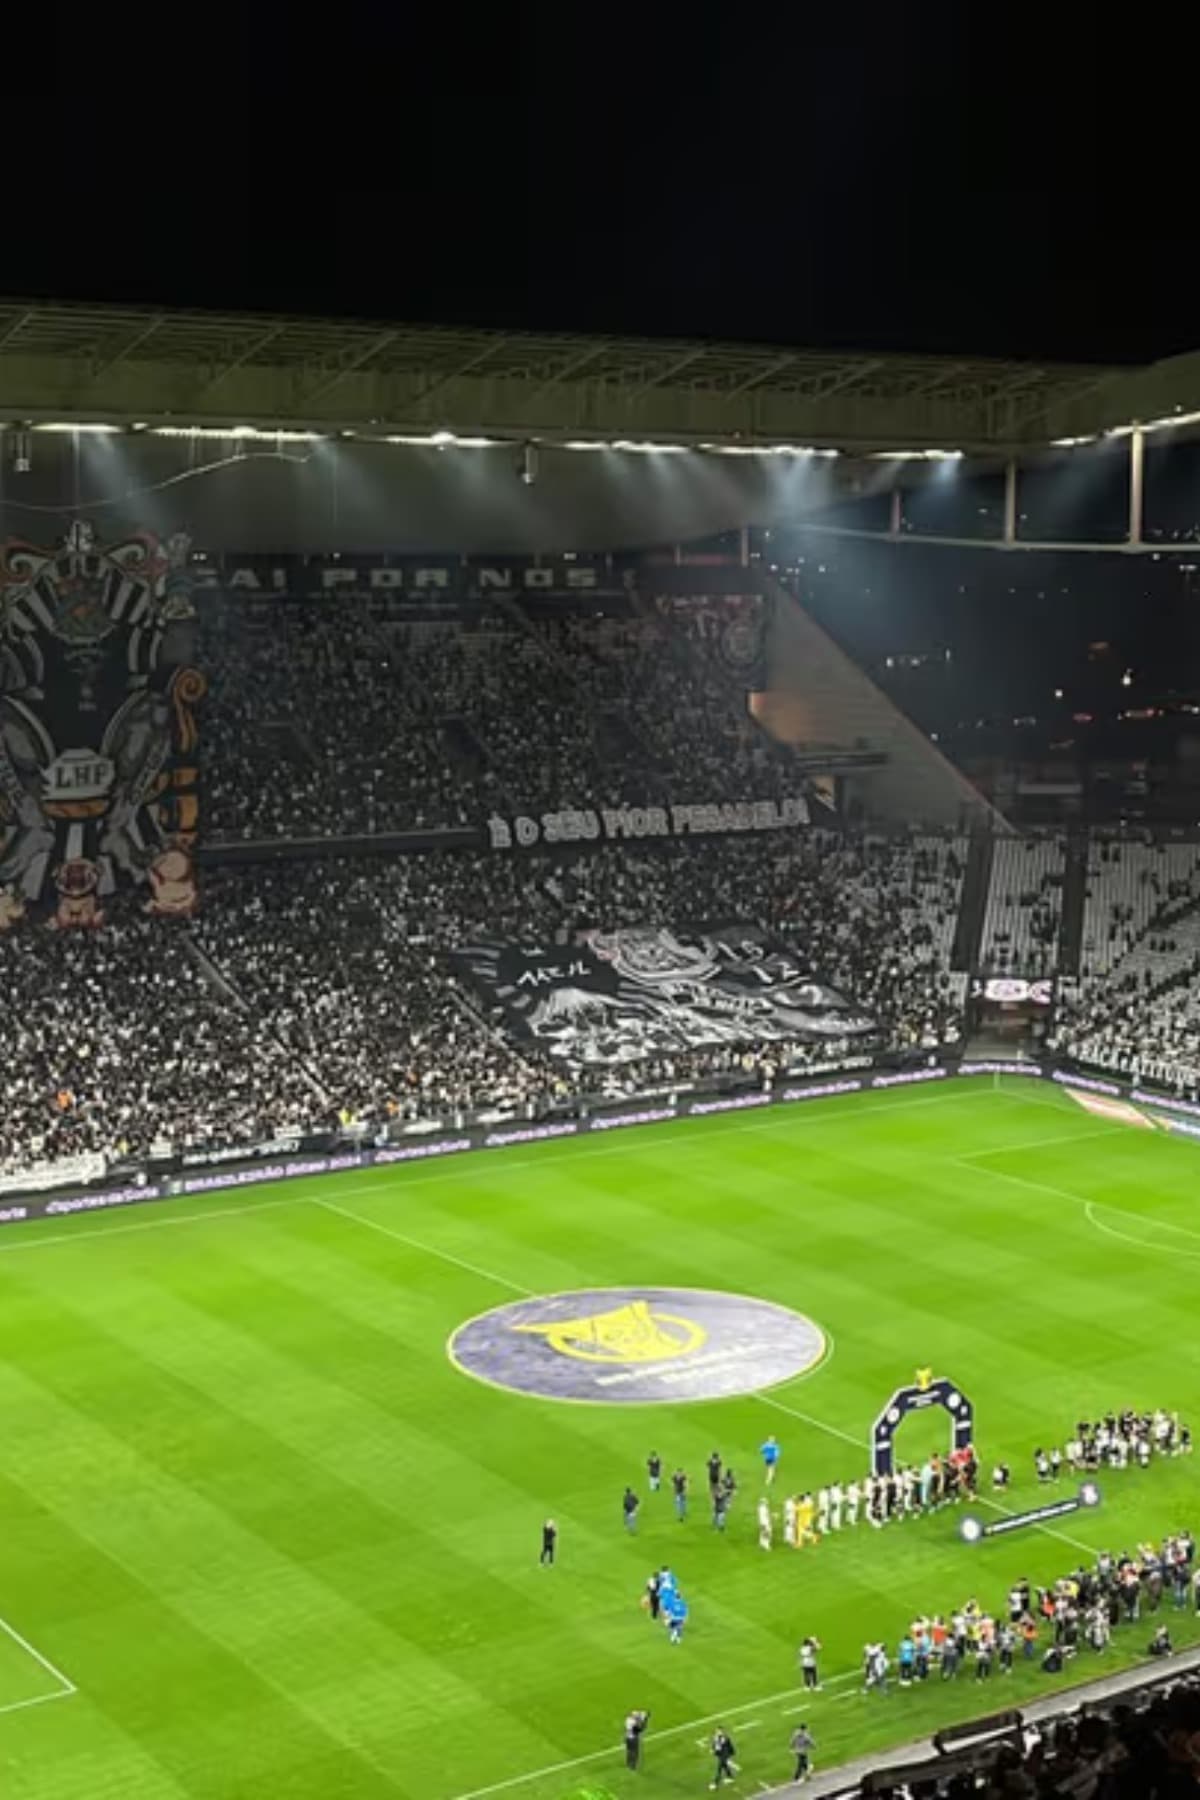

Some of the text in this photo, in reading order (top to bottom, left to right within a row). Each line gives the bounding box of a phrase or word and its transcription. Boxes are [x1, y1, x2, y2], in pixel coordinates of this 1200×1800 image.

[322, 568, 449, 588] POR
[514, 815, 539, 846] O
[601, 806, 669, 839] PIOR
